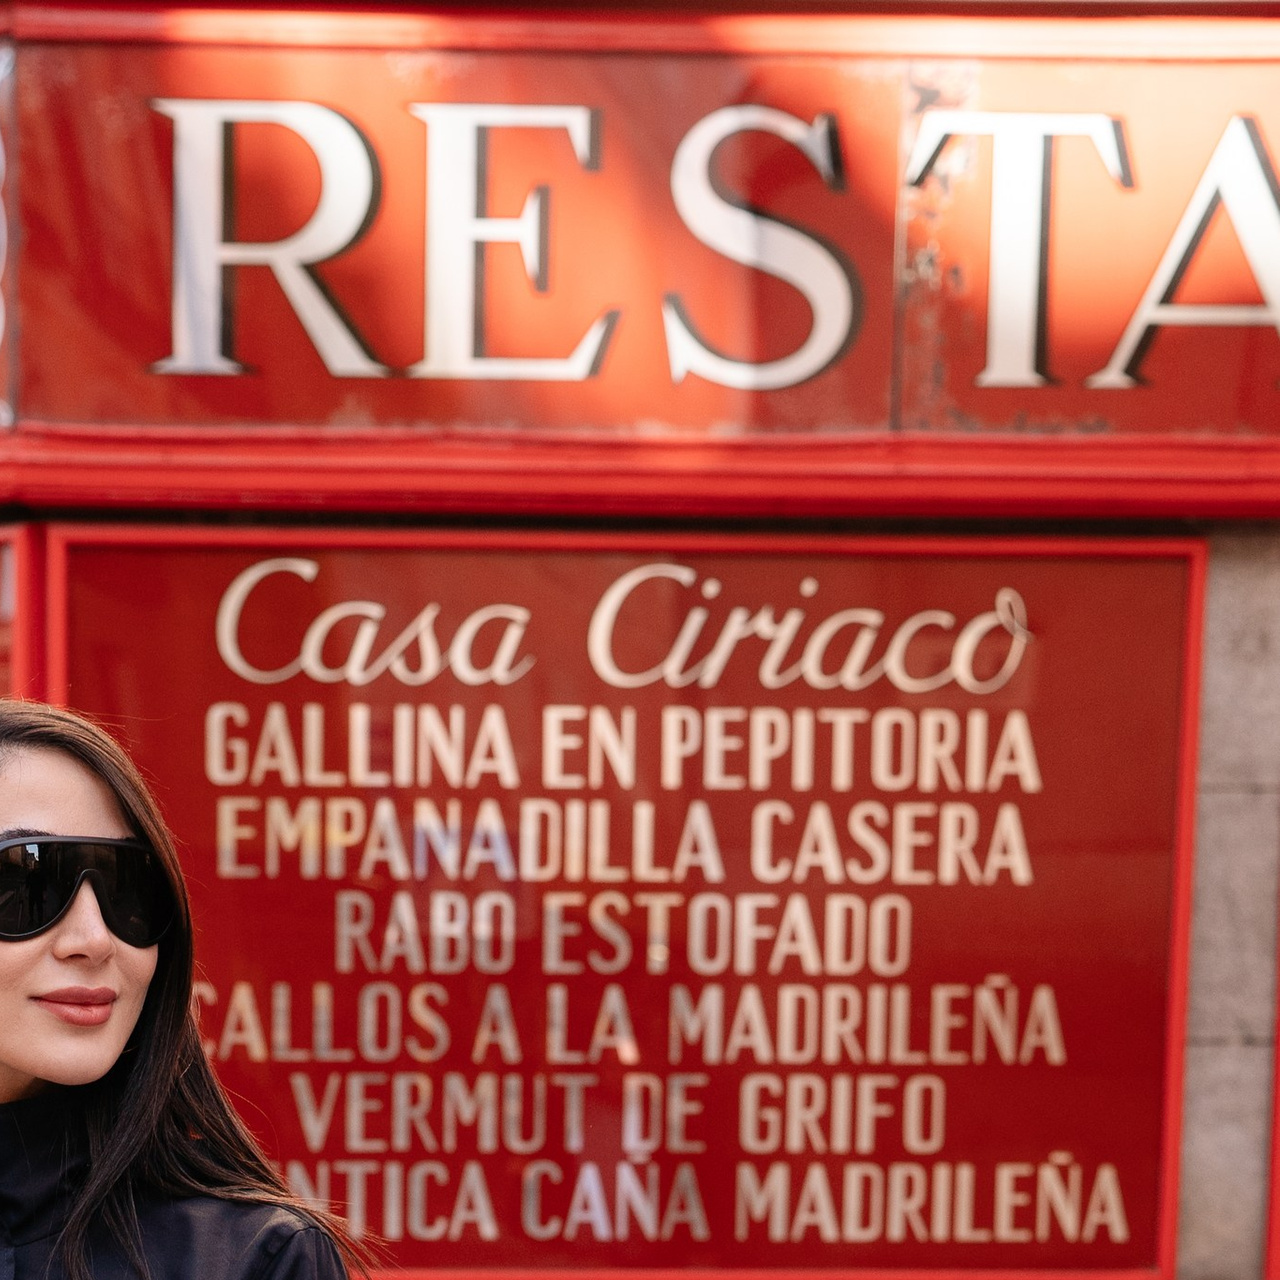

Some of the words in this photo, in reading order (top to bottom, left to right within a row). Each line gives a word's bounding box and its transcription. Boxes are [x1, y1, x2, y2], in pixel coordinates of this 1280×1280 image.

[215, 557, 536, 686] Casa
[587, 563, 1035, 695] Ciriaco
[204, 702, 520, 789] GALLINA
[542, 704, 637, 790] EN
[661, 705, 1043, 793] PEPITORIA
[216, 796, 725, 883] EMPANADILLA
[750, 800, 1034, 886] CASERA
[334, 891, 517, 975] RABO
[542, 891, 913, 976] ESTOFADO
[471, 983, 522, 1064] A
[546, 983, 641, 1065] LA
[667, 973, 1068, 1066] MADRILEÑA
[289, 1072, 598, 1154] VERMUT
[622, 1072, 710, 1154] DE
[739, 1073, 947, 1155] GRIFO
[276, 1159, 500, 1242] NTICA
[520, 1150, 711, 1242] CAÑA
[734, 1150, 1131, 1243] MADRILEÑA
